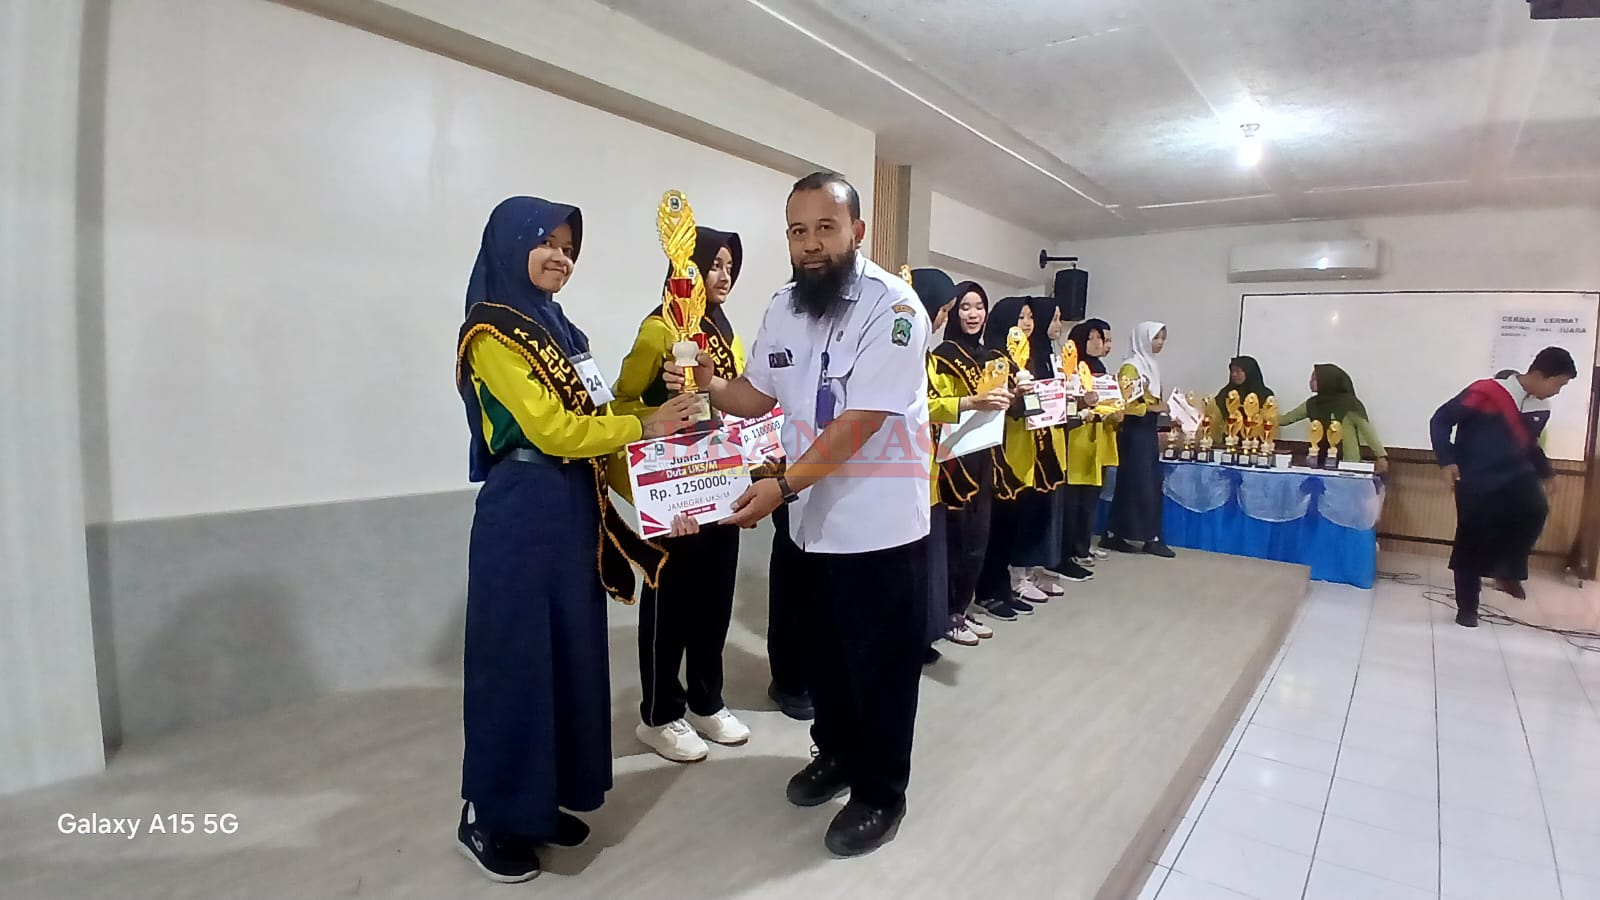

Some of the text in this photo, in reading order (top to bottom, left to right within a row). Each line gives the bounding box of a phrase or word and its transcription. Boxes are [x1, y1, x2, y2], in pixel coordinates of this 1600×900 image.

[513, 327, 584, 415] KABUPATE
[545, 344, 588, 406] DUTA
[585, 374, 603, 392] 24
[670, 450, 709, 466] Juara 1
[666, 460, 718, 479] Duta UKS/M
[649, 487, 672, 502] Rp.
